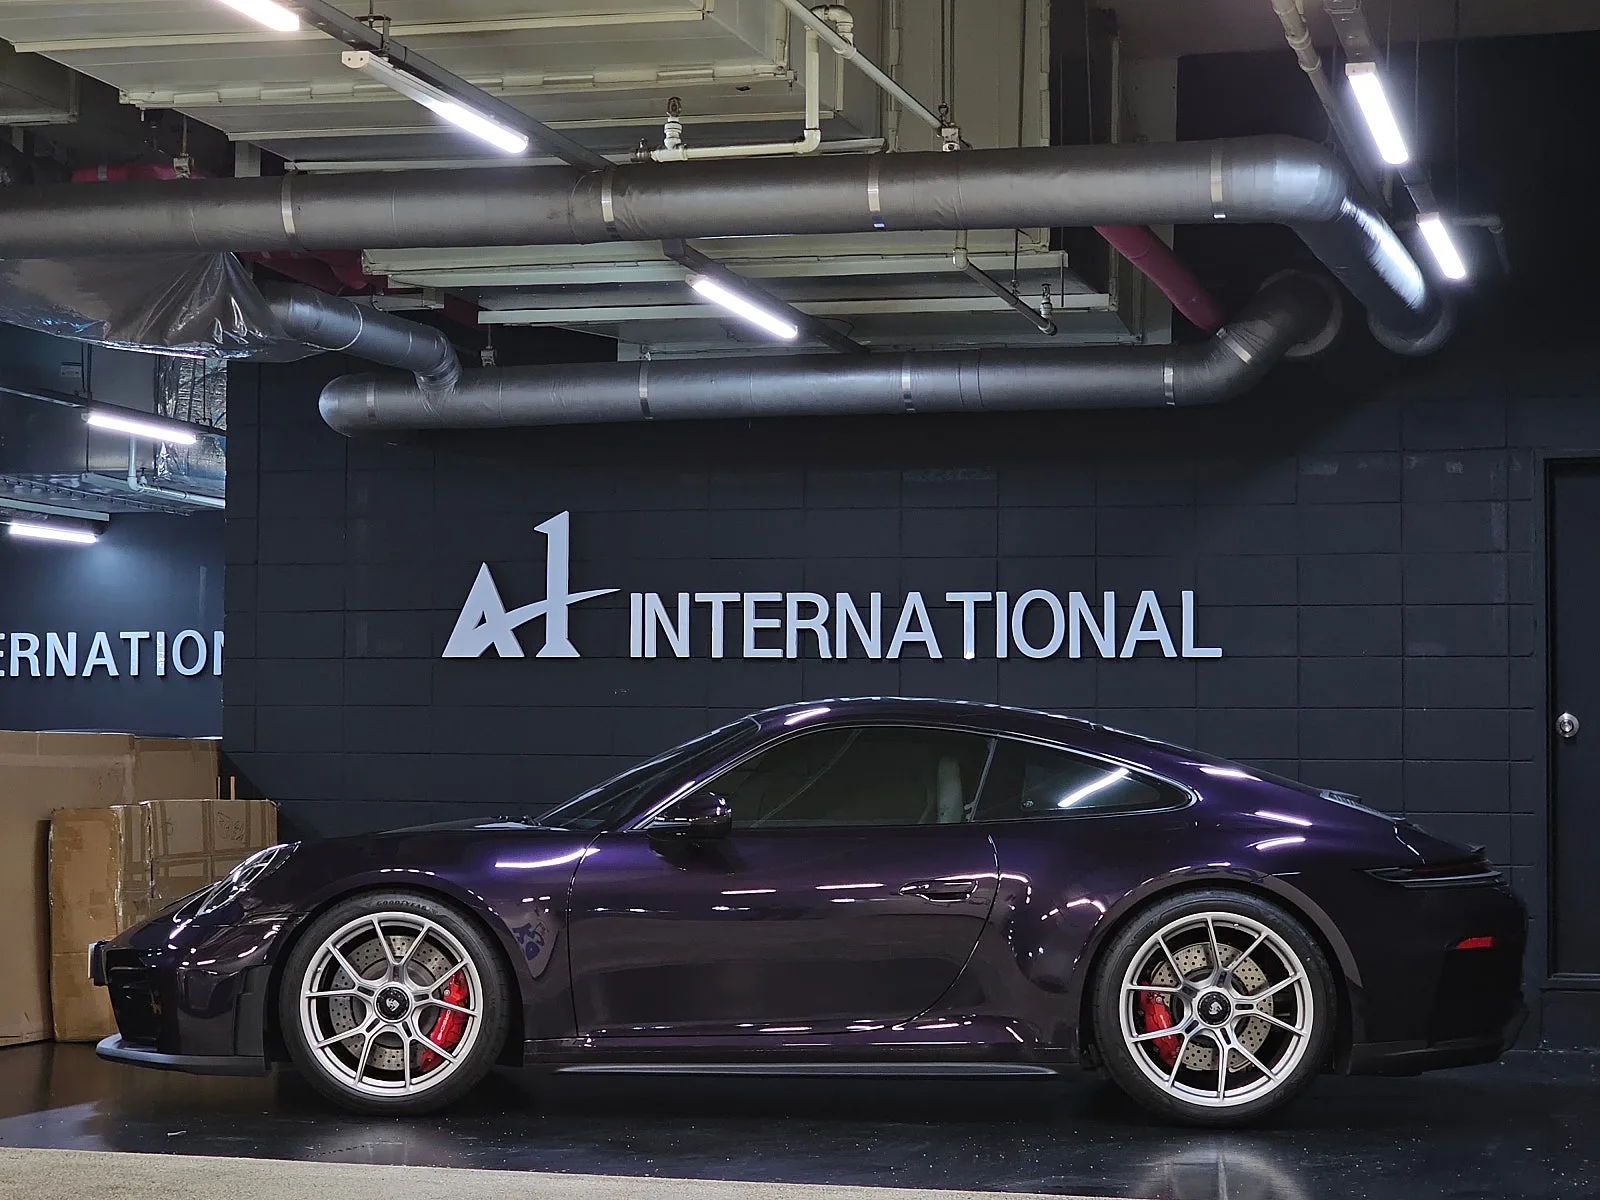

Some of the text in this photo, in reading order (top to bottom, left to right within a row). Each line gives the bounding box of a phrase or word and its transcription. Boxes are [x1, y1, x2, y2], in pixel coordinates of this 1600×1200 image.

[441, 510, 1222, 659] A1 INTERNATIONAL
[0, 629, 224, 677] RNATIO
